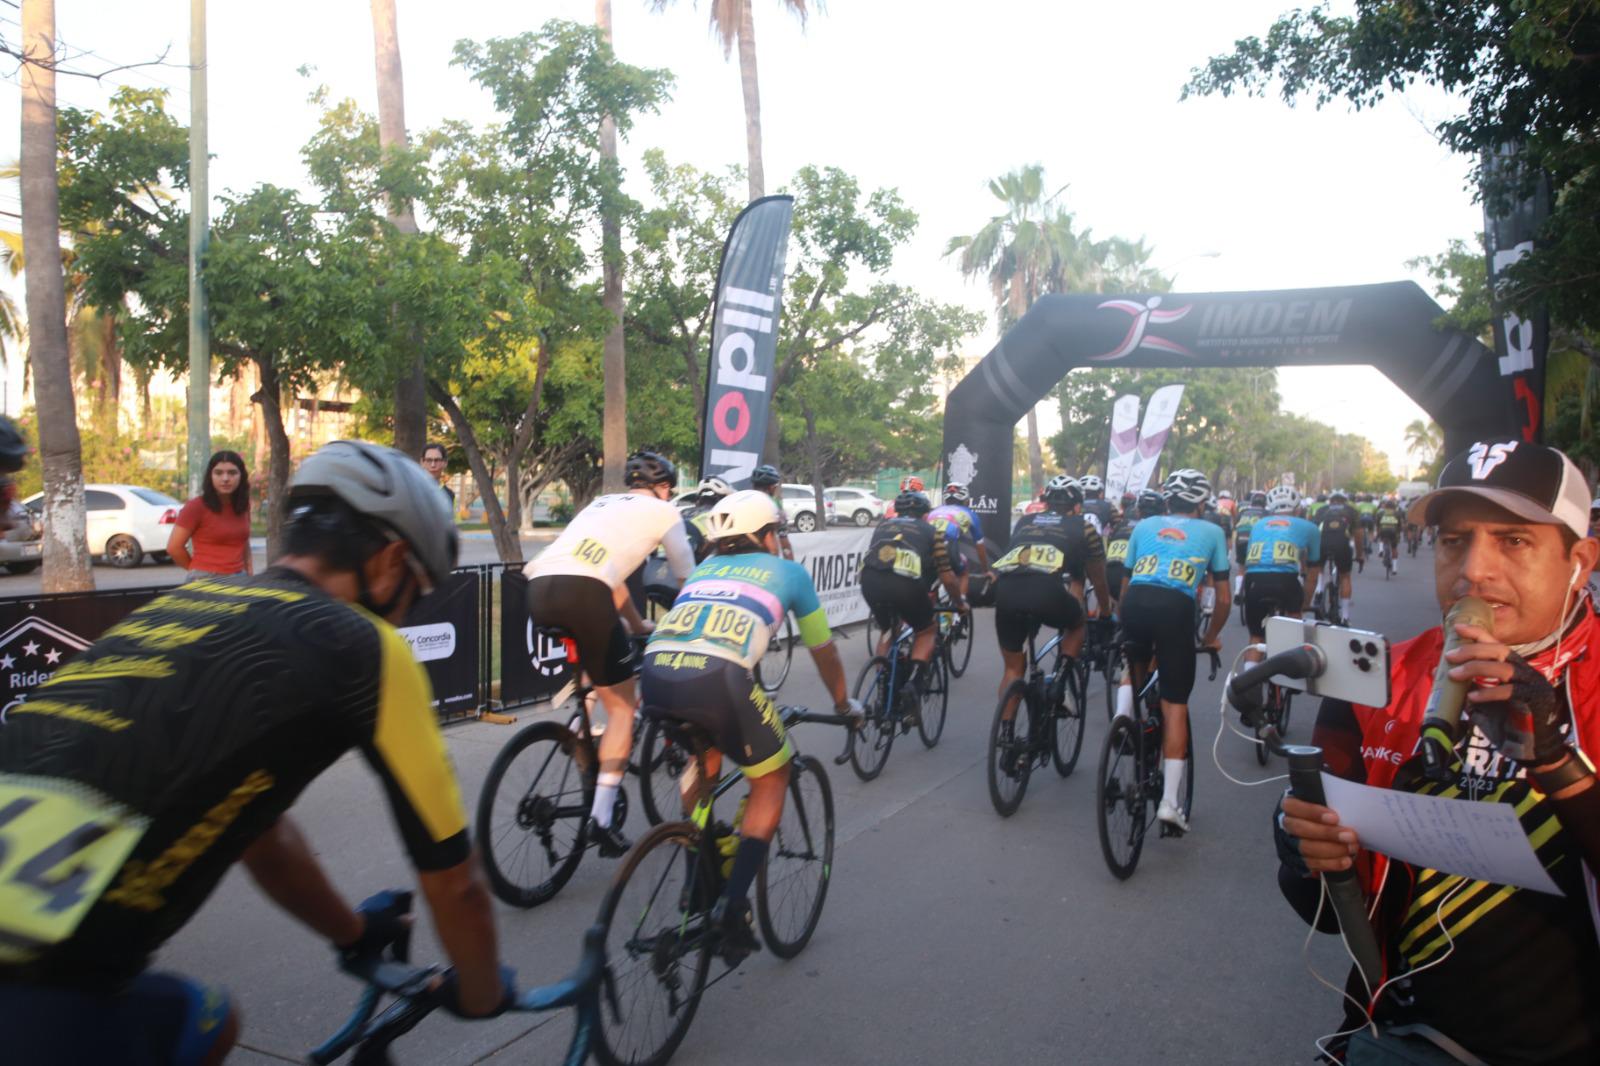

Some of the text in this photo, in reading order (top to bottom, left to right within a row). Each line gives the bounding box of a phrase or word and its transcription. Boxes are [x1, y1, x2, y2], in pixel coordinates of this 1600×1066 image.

[1198, 301, 1353, 337] IMDEM
[575, 538, 607, 565] 140
[1277, 543, 1296, 557] 90
[1134, 556, 1158, 574] 89
[1170, 560, 1195, 583] 89
[711, 608, 749, 637] 108
[416, 631, 452, 646] Concordia
[1459, 777, 1494, 791] 2023
